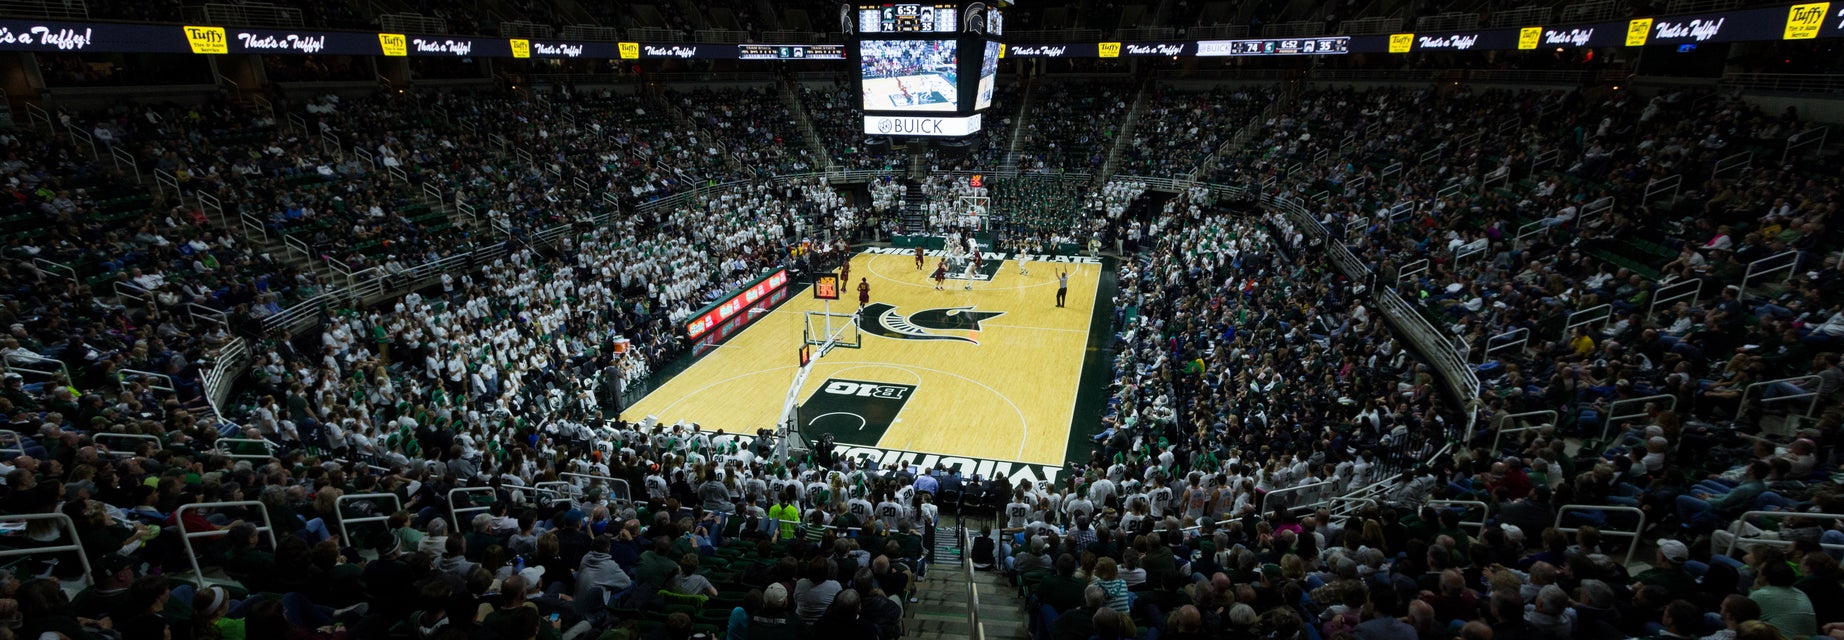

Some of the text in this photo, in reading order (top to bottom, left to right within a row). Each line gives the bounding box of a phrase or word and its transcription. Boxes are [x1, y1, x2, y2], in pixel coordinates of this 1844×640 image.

[897, 5, 917, 15] 6:52
[1792, 6, 1824, 24] Tuffy
[884, 23, 893, 31] 74
[922, 23, 932, 31] 35
[18, 33, 33, 44] a
[31, 26, 91, 49] Tuffy!
[187, 29, 223, 43] Tuffy
[380, 35, 404, 47] Tuffy
[1419, 36, 1443, 48] That's
[1450, 34, 1478, 49] Tuffy!
[238, 33, 278, 49] That's
[287, 34, 324, 53] Tuffy!
[413, 39, 440, 52] That's
[445, 39, 471, 55] Tuffy!
[1247, 42, 1258, 51] 74
[1281, 40, 1298, 49] 6:52
[1320, 41, 1331, 50] 35
[534, 43, 556, 54] That's
[560, 44, 582, 57] Tuffy!
[644, 46, 667, 56] That's
[672, 46, 696, 58] Tuffy!
[1011, 46, 1034, 56] That's
[1040, 46, 1066, 57] Tuffy!
[1127, 44, 1151, 55] That's
[1157, 43, 1184, 56] Tuffy!
[894, 119, 943, 134] BUICK
[714, 455, 724, 463] 20
[773, 482, 784, 492] 20
[903, 488, 914, 500] 20
[1156, 491, 1169, 502] 20
[851, 503, 864, 514] 20
[883, 506, 896, 518] 20
[1012, 507, 1026, 518] 20
